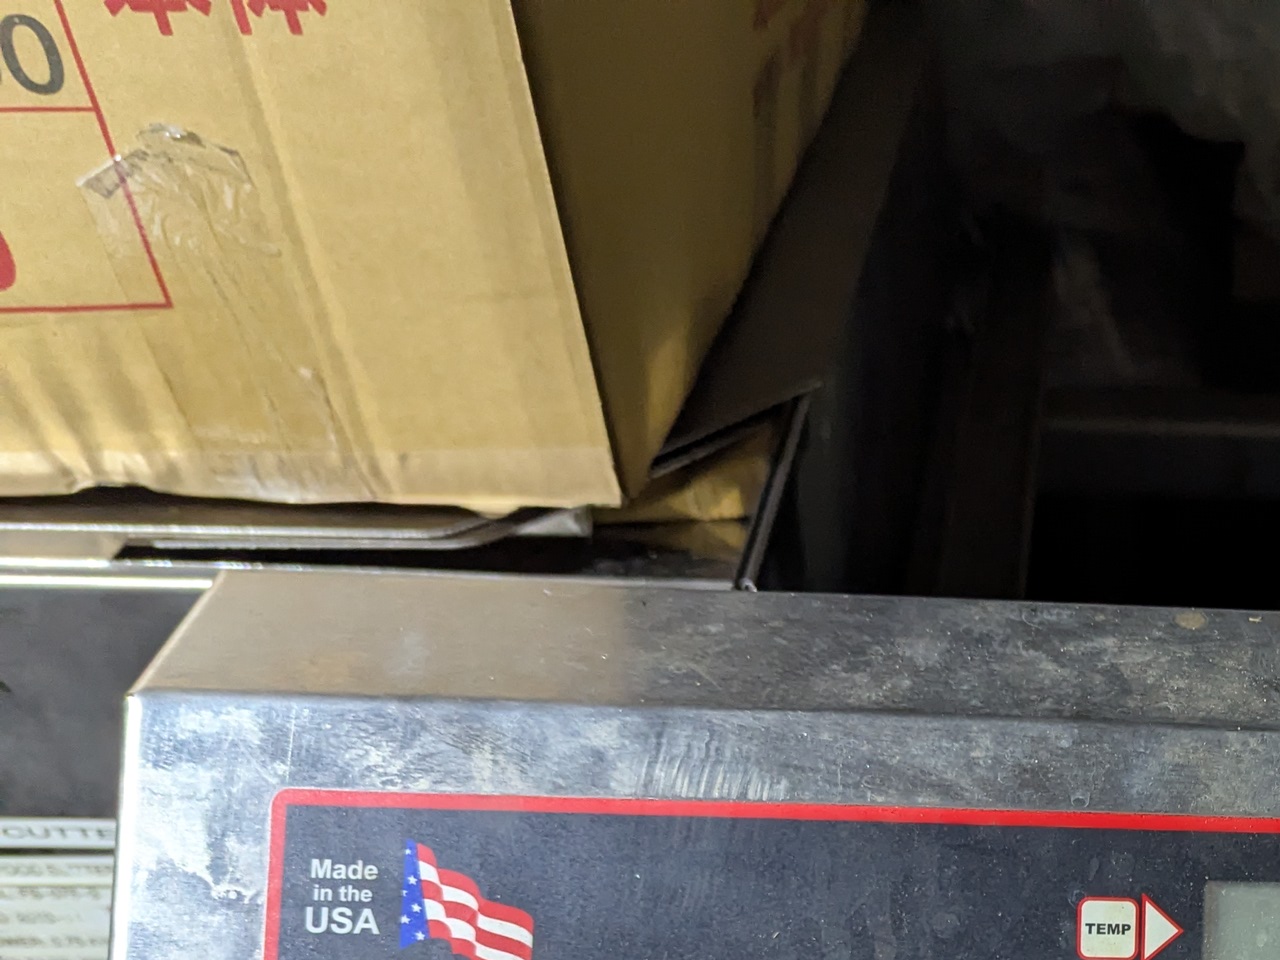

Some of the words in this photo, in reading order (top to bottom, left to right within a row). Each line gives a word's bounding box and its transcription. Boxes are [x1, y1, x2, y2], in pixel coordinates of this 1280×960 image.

[0, 14, 65, 95] 0
[310, 858, 379, 881] Made
[313, 885, 332, 902] in
[339, 886, 373, 902] the
[304, 907, 380, 935] USA
[1085, 923, 1132, 936] TEMP
